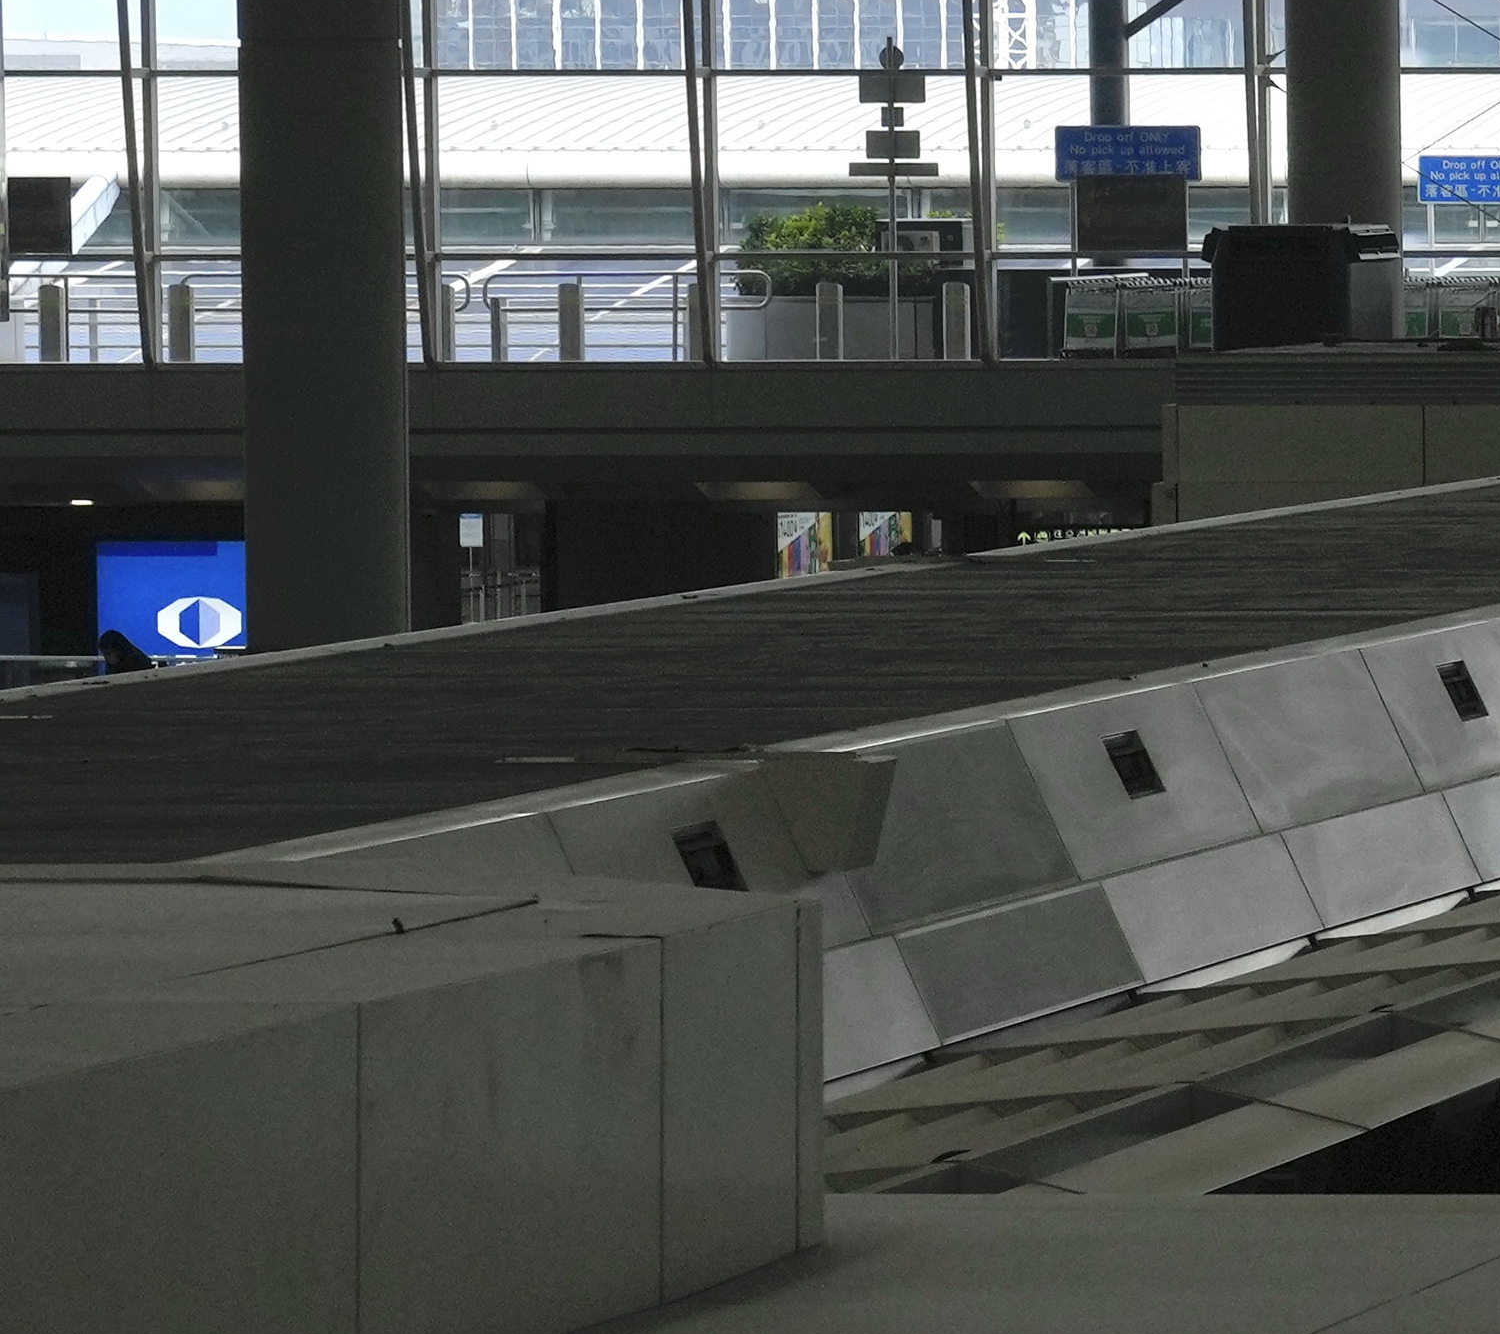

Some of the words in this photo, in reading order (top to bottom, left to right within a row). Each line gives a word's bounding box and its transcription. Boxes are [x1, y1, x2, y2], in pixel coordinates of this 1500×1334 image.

[1084, 131, 1112, 143] Drop
[1116, 131, 1134, 142] off
[1139, 132, 1170, 143] ONLY
[1070, 145, 1086, 155] No
[1092, 145, 1115, 156] pick
[1139, 145, 1185, 156] allowed
[1442, 160, 1466, 171] Drop
[1471, 160, 1486, 170] off
[1430, 171, 1445, 181] No
[1449, 171, 1470, 182] pick
[1474, 172, 1487, 182] up
